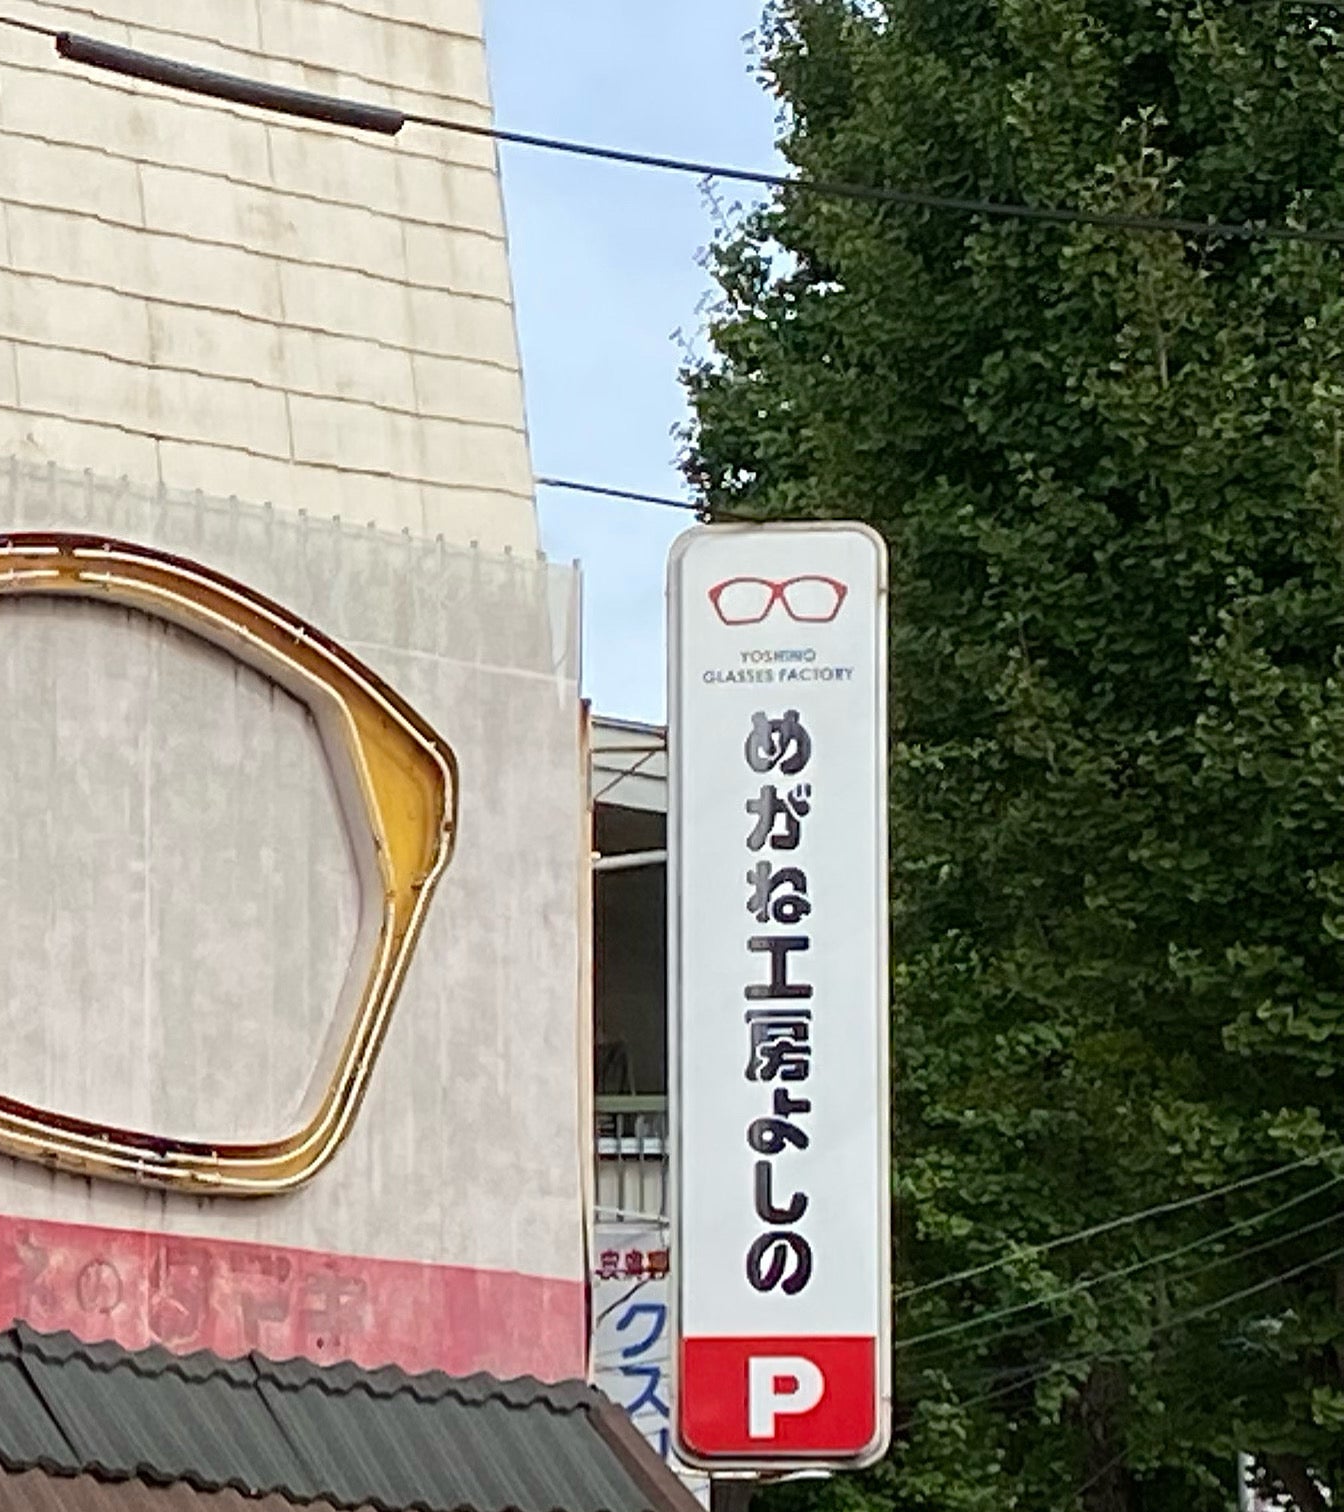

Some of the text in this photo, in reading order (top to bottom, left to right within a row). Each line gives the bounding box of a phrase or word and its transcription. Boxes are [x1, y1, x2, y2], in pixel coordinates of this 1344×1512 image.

[703, 668, 854, 683] GLASSES FACTORY
[740, 649, 816, 663] YOSHINO
[743, 709, 813, 1295] めがね工房よしの
[748, 1355, 825, 1439] P
